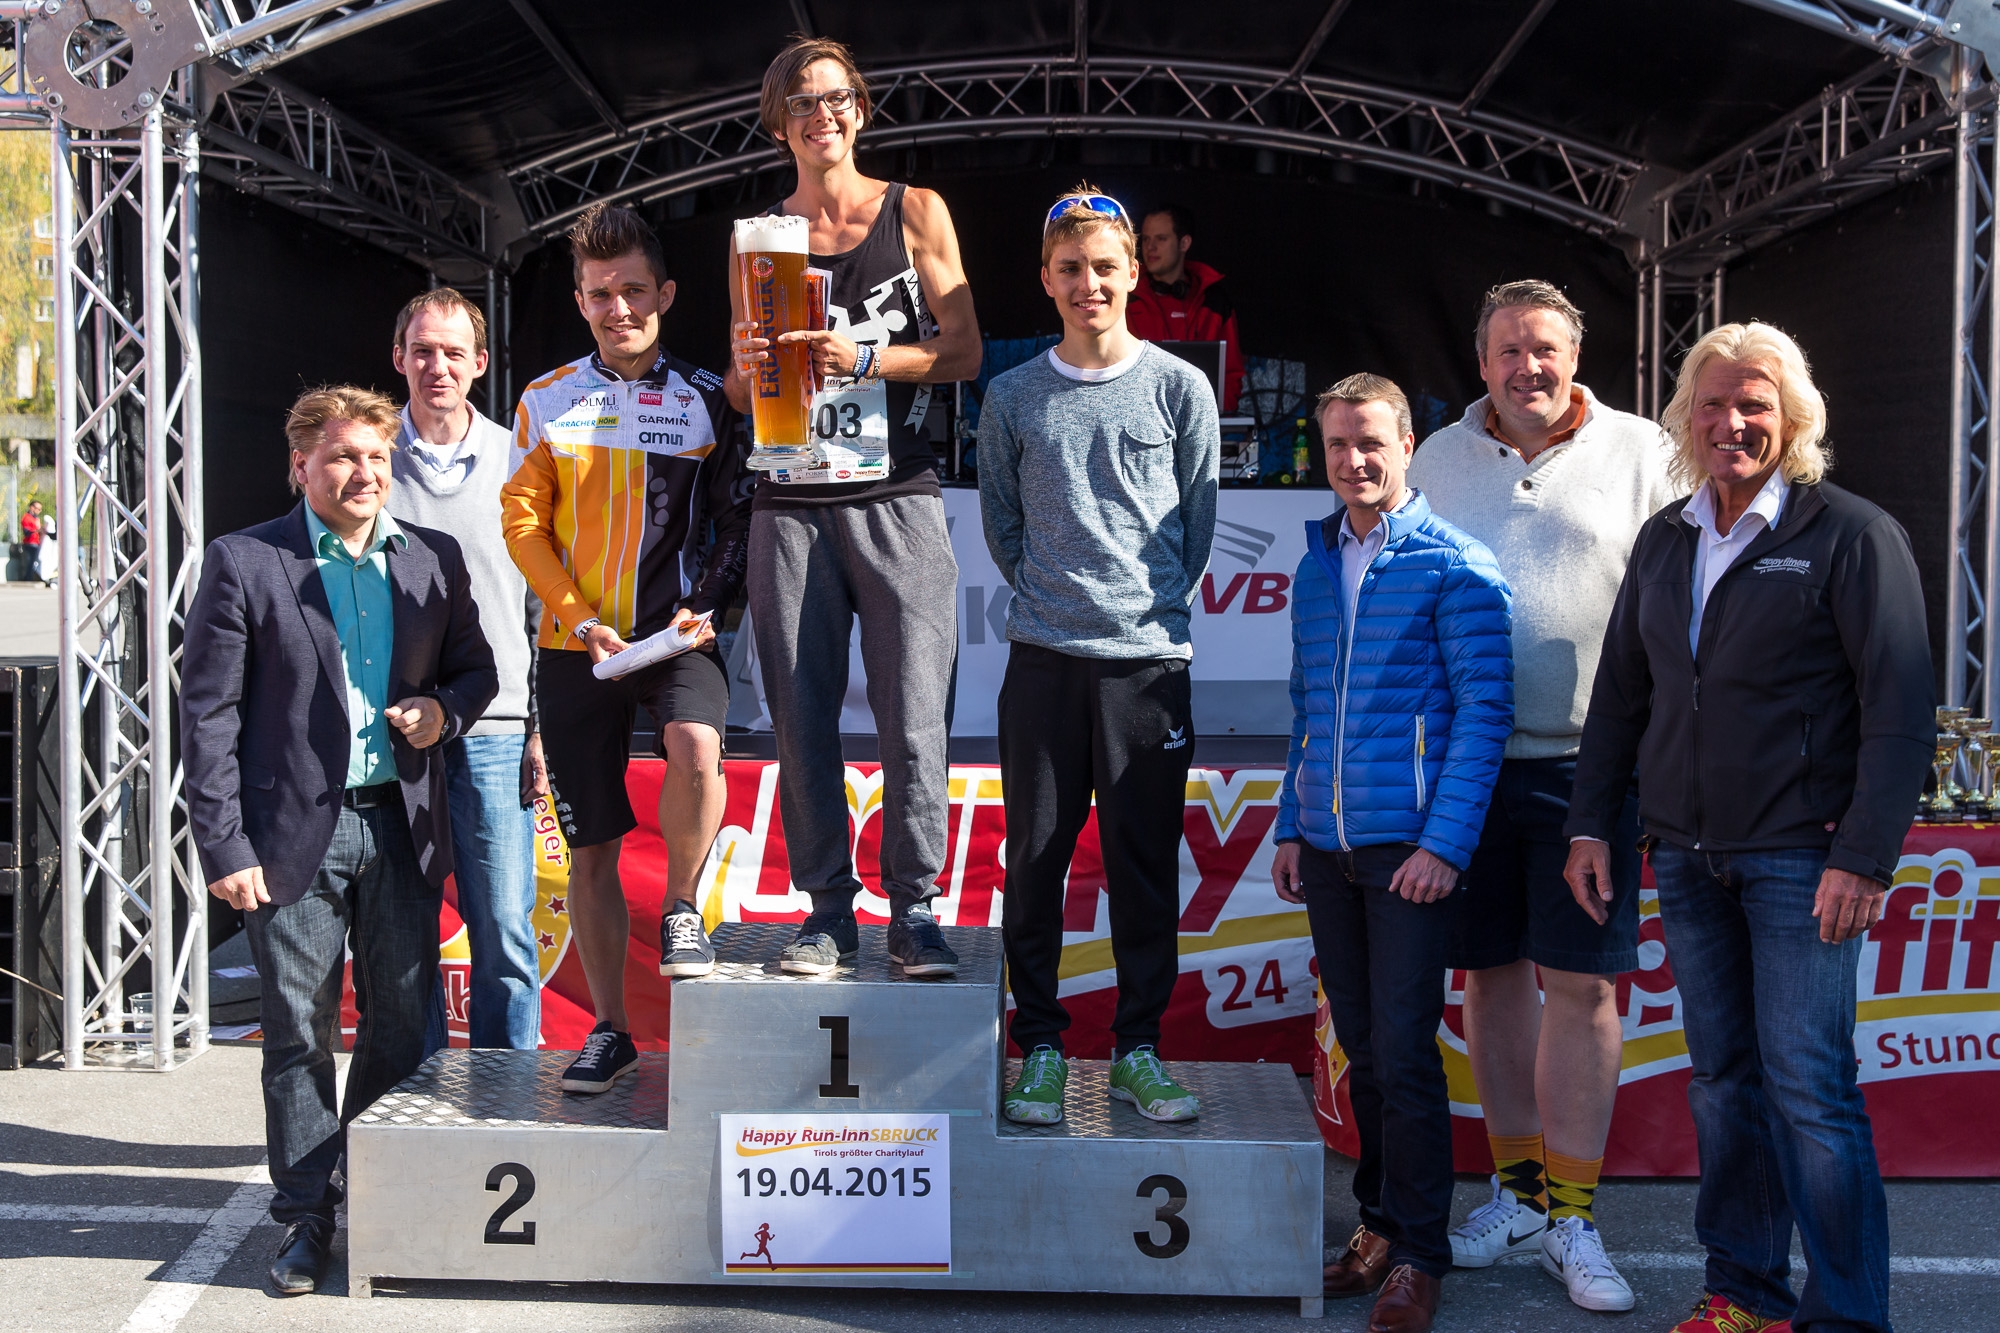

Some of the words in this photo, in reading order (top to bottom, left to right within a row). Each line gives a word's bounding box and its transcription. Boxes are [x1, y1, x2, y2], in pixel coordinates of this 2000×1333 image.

[757, 277, 781, 399] ERDINGER
[691, 375, 716, 391] Group
[549, 419, 596, 428] TURRACHER
[598, 417, 617, 425] HÖHE
[638, 415, 690, 426] GARMIN
[1164, 737, 1187, 750] erima
[1217, 959, 1289, 1012] 24
[818, 1015, 860, 1098] 1
[741, 1127, 797, 1146] Happy
[814, 1149, 838, 1157] Tirols
[840, 1149, 873, 1158] größter
[875, 1148, 924, 1158] Charitylauf
[736, 1166, 932, 1198] 19.04.2015
[483, 1161, 537, 1246] 2
[1133, 1173, 1191, 1259] 3
